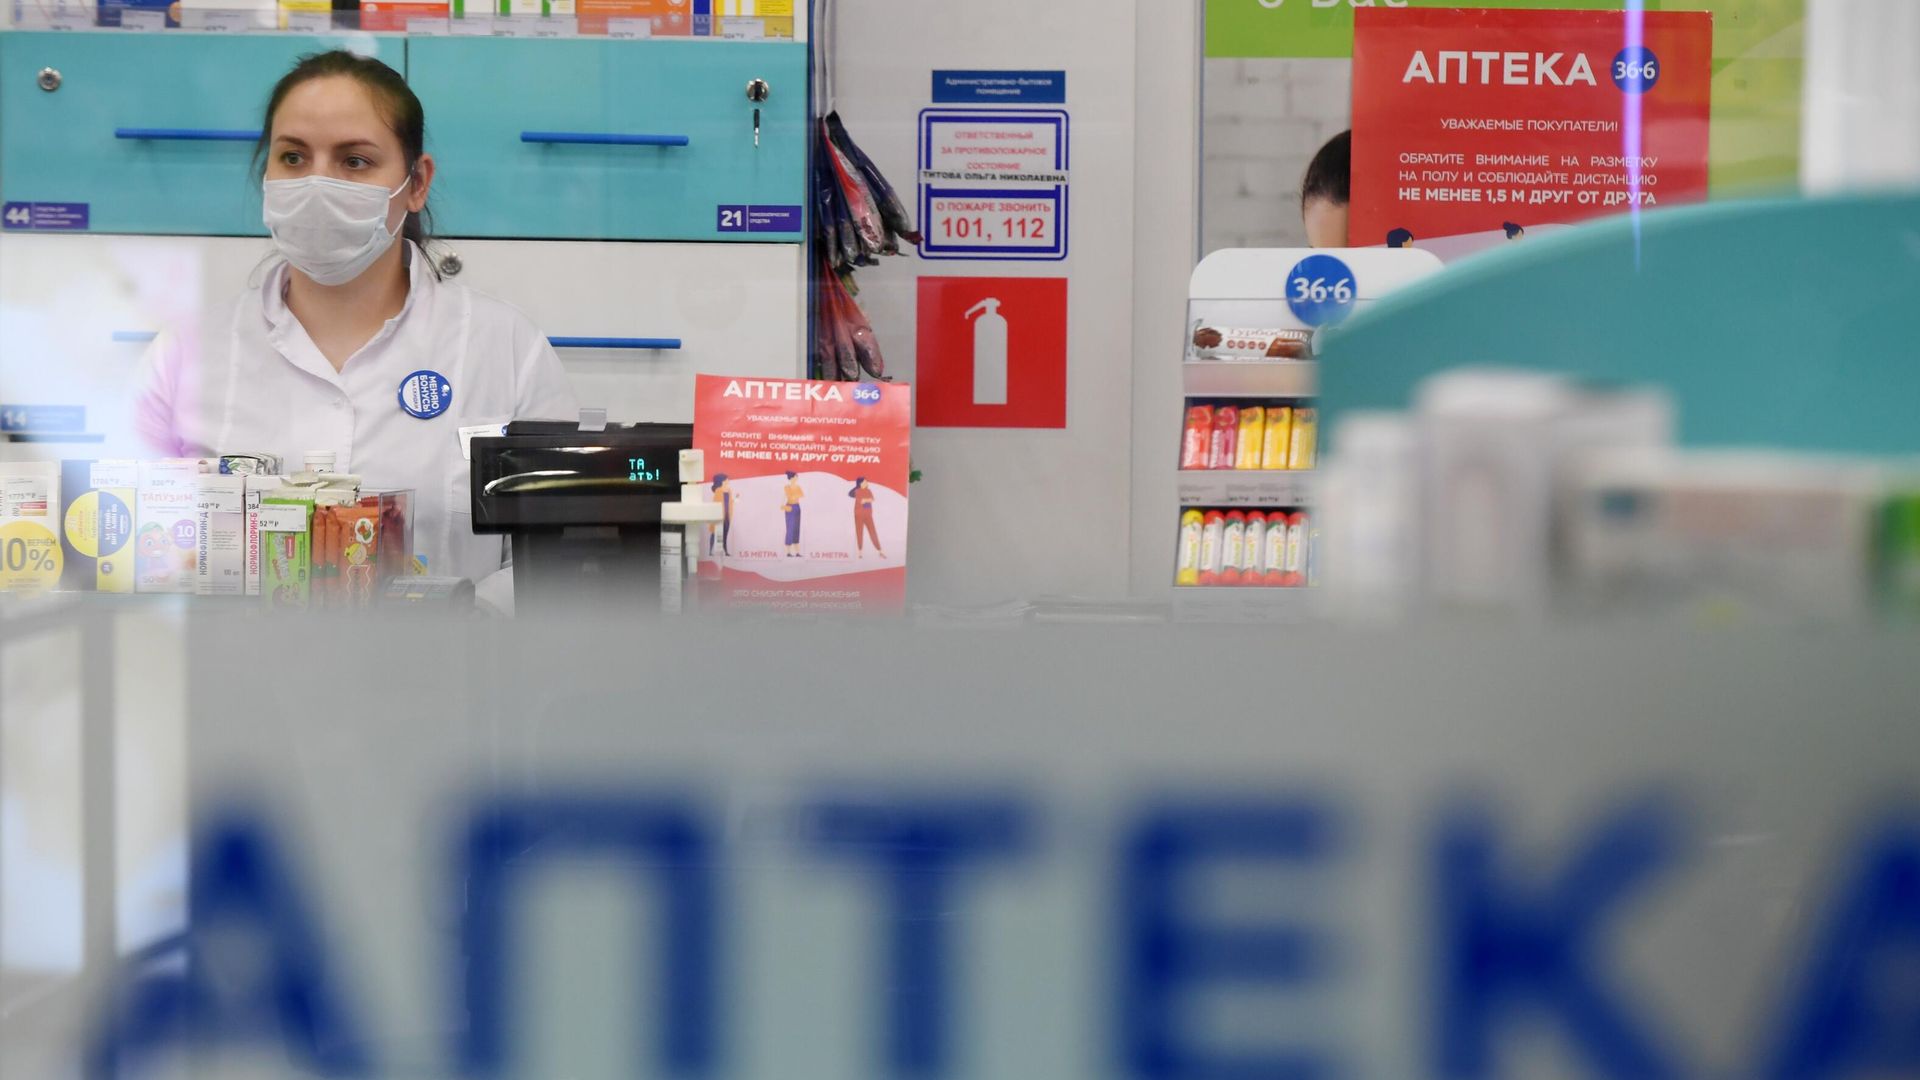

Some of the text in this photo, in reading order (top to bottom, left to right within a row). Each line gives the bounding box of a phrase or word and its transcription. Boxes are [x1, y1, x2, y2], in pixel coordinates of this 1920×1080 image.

[1402, 50, 1597, 86] АПТЕКА
[1441, 119, 1618, 132] УВАЖАЕМЫЕ ПОКУПАТЕЛИ!
[955, 131, 1032, 140] ОТВЕТСТВЕННЫЙ
[955, 147, 1046, 155] ПРОТИВОПОЖАРНОЕ
[967, 162, 1020, 170] СОСТОЯНИЕ
[1400, 153, 1658, 168] ОБРАТИТЕ ВНИМАНИЕ НА РАЗМЕТКУ
[922, 171, 961, 180] ТИТОВА
[1000, 174, 1066, 182] НИКОЛАЕВНА
[1400, 171, 1657, 186] НА ПОЛУ И СОБЛЮДАЙТЕ ДИСТАНЦИЮ
[1399, 188, 1656, 205] НЕ МЕНЕЕ 1,5 М ДРУГ ОТ ДРУГА
[936, 202, 1051, 212] О ПОЖАРЕ ЗВОНИТЬ
[6, 208, 30, 224] 44
[722, 210, 742, 226] 21
[942, 218, 1044, 242] 101, 112
[420, 375, 431, 412] БОНУСЫ
[429, 376, 440, 410] МЕНЯЮ
[723, 380, 844, 402] АПТЕКА
[4, 411, 27, 426] 14
[746, 415, 856, 425] УВАЖАЕМЫЕ ПОКУПАТЕЛИ!
[768, 434, 814, 442] ВНИМАНИЕ
[840, 436, 880, 444] РАЗМЕТКУ
[770, 442, 824, 451] СОБЛЮДАЙТЕ
[828, 445, 880, 454] ДИСТАНЦИЮ
[629, 458, 644, 470] ТА
[720, 450, 734, 458] НЕ
[737, 452, 772, 460] МЕНЕЕ
[775, 452, 788, 461] 1,5
[790, 453, 799, 461] М
[801, 453, 828, 462] ДРУГ
[847, 454, 880, 463] ДРУГА
[176, 525, 194, 538] 10
[200, 512, 208, 576] НОРМОФЛОРИН-Д
[250, 512, 258, 574] НОРМОФЛОРИН-Б
[82, 788, 1920, 1080] АПТЕКА
